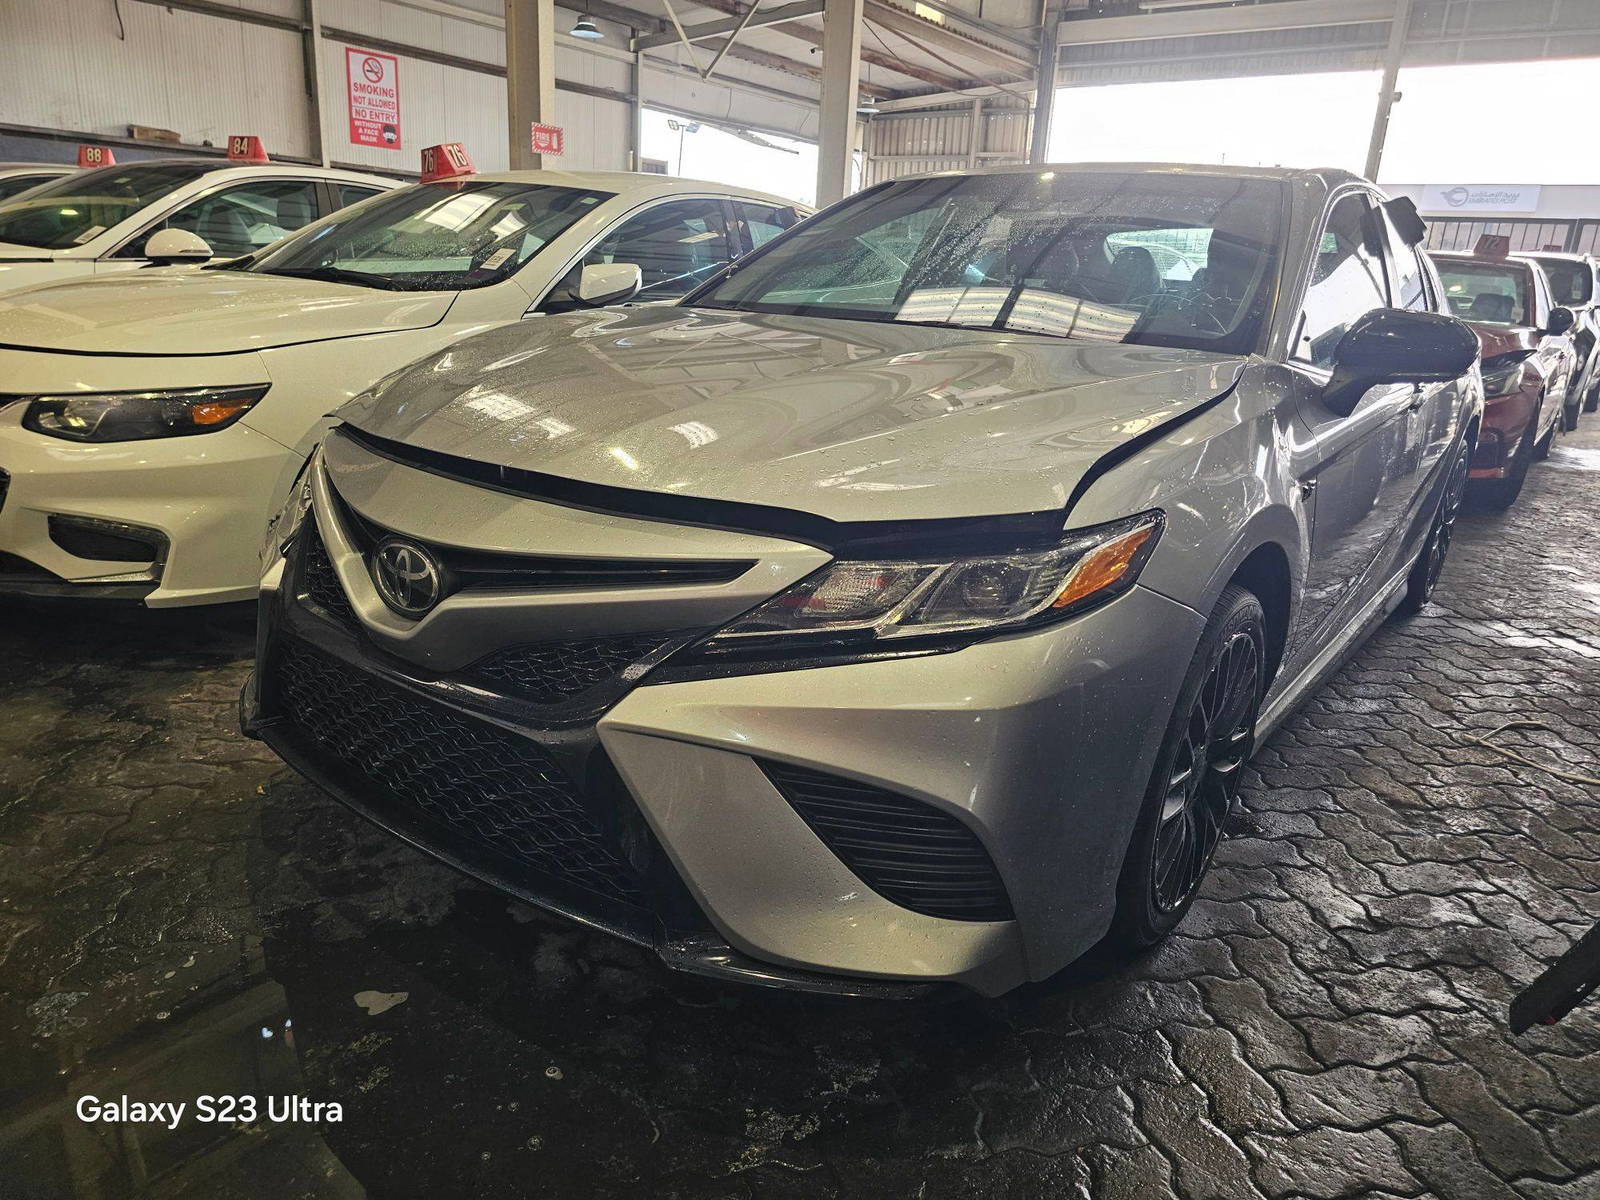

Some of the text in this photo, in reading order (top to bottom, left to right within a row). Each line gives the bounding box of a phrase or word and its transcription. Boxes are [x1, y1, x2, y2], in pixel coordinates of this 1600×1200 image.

[353, 82, 395, 98] SMOKING
[353, 95, 395, 110] NOT ALLOWED
[354, 108, 396, 122] NO ENTRY
[354, 120, 382, 129] WITHOUT
[362, 128, 379, 136] FACE
[535, 131, 550, 141] FIRE
[233, 137, 248, 154] 84
[86, 147, 102, 162] 88
[424, 149, 434, 173] 76
[447, 144, 468, 168] 76
